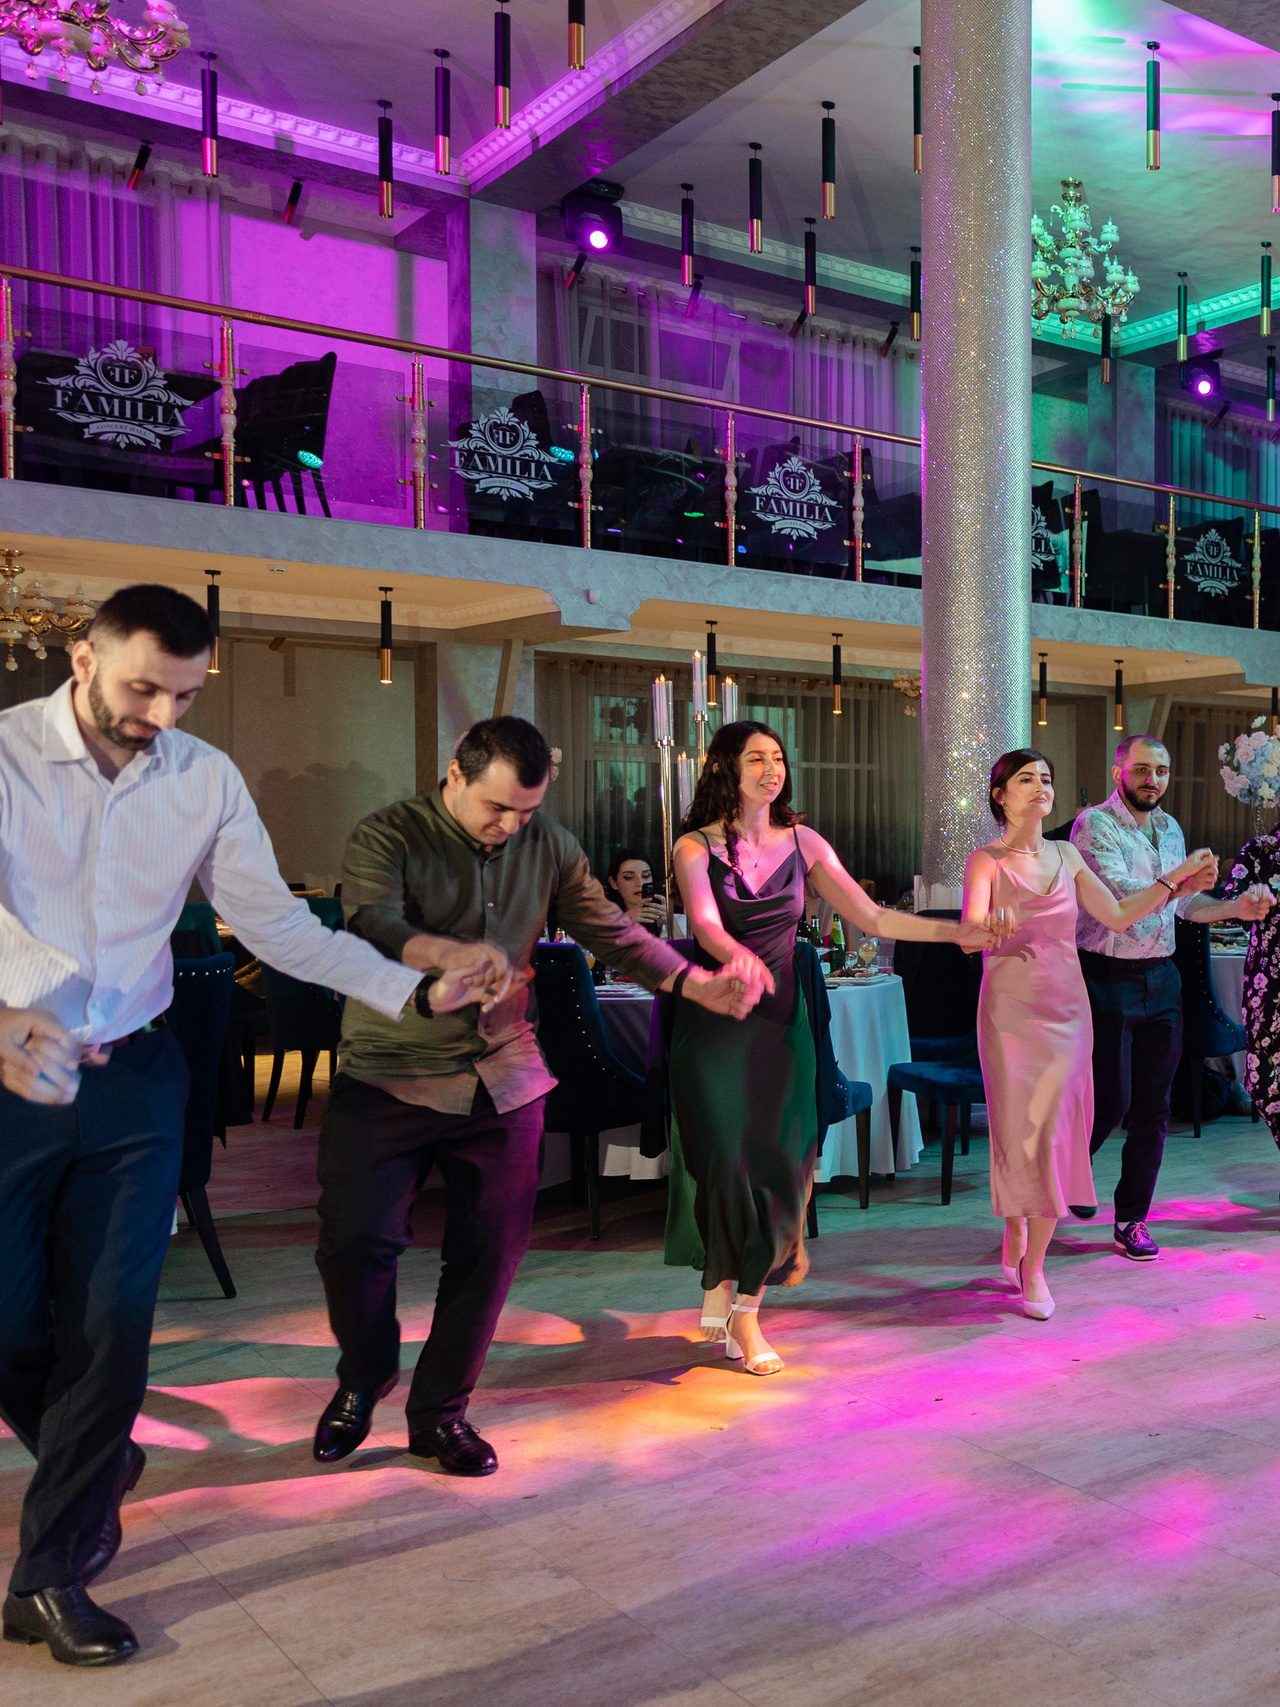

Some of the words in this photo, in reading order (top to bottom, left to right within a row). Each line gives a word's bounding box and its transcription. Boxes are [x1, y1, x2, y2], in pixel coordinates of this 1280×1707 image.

[54, 388, 186, 427] FAMILIA
[130, 426, 147, 435] HALL
[453, 450, 553, 481] FAMILIA
[755, 496, 832, 522] FAMILIA
[1186, 561, 1239, 581] FAMILIA
